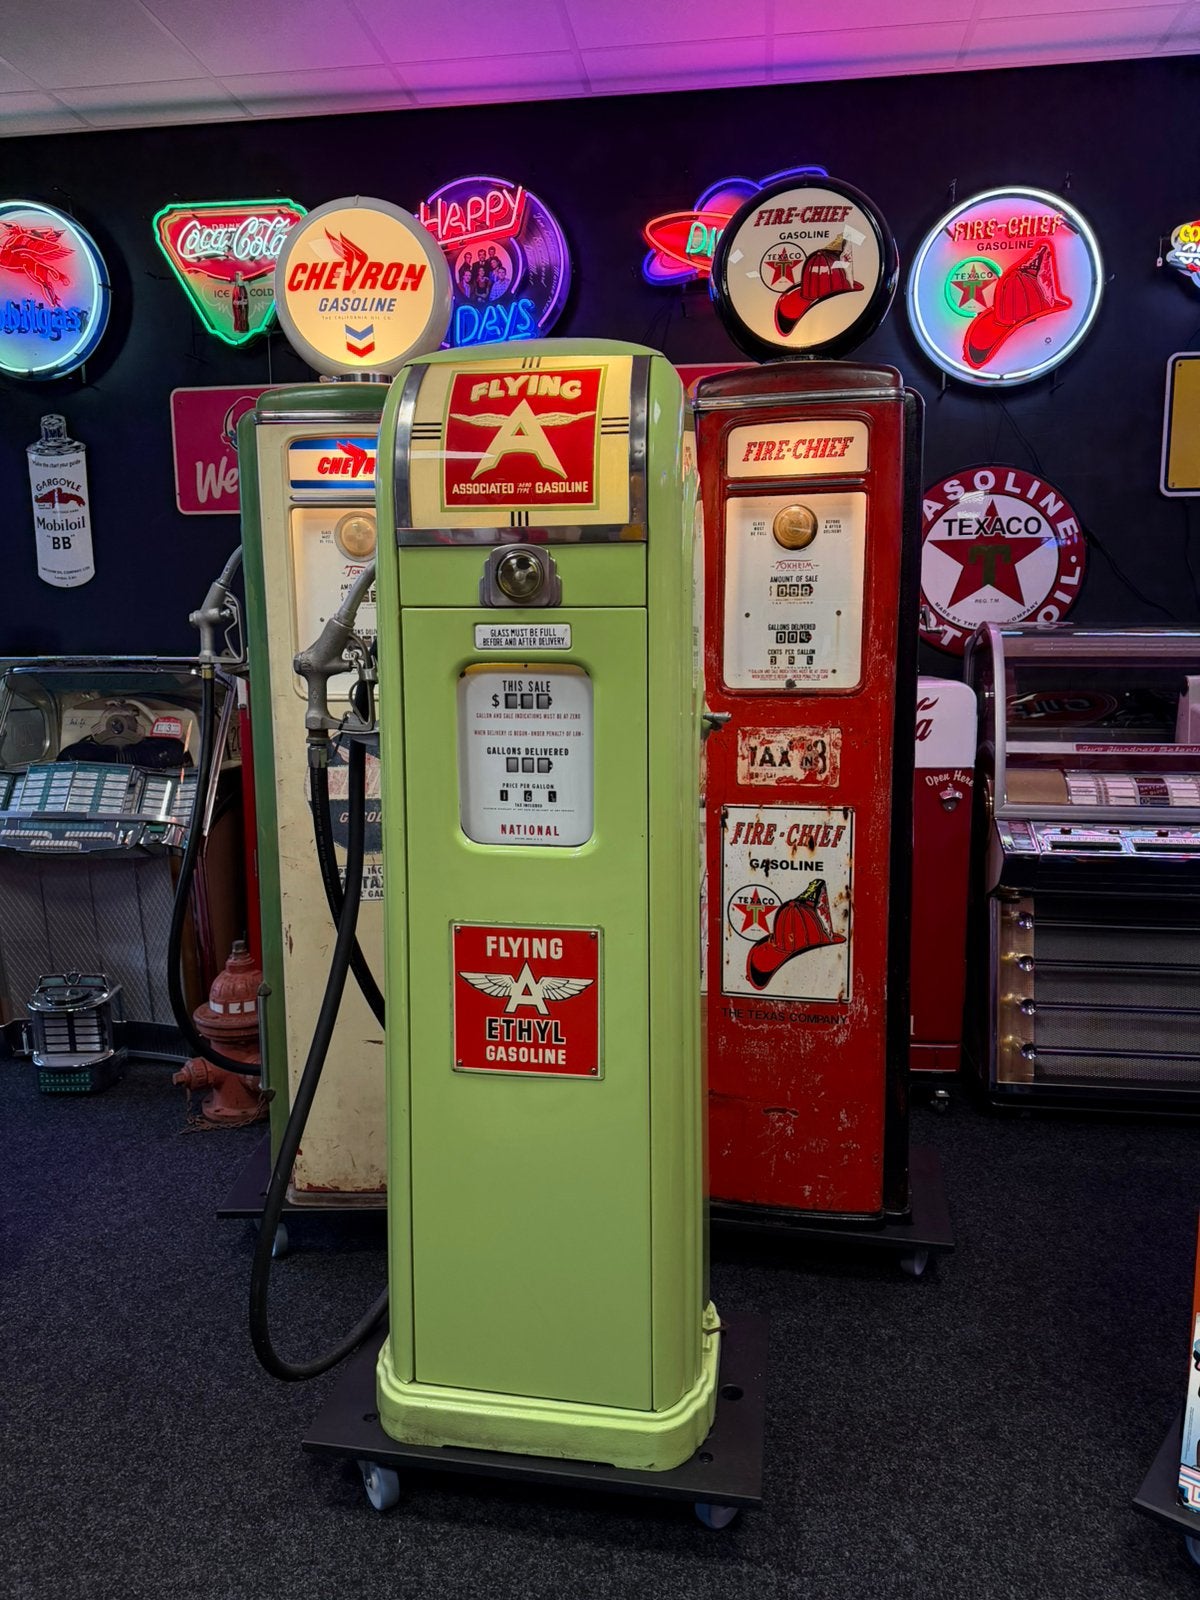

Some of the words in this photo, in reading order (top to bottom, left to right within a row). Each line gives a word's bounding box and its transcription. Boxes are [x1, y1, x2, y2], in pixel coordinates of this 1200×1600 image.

[420, 186, 523, 240] HAPPY
[754, 205, 853, 227] FIRE-CHIEF
[779, 230, 830, 240] GASOLINE
[954, 213, 1064, 242] FIRE-CHIEF
[177, 216, 290, 259] Coca-Cola
[976, 240, 1035, 251] GASOLINE
[767, 252, 801, 261] TEXACO
[287, 253, 428, 293] CHEVRON
[954, 271, 994, 280] TEXACO
[213, 290, 231, 298] ICE
[249, 288, 274, 297] COLD
[318, 297, 397, 312] GASOLINE
[456, 299, 534, 345] DAYS
[470, 374, 582, 402] FLYING
[742, 436, 854, 462] FIRE-CHIEF
[317, 451, 376, 478] CHEVR
[35, 477, 82, 492] GARGOYLE
[195, 455, 239, 504] We
[452, 482, 515, 494] ASSOCIATED
[535, 481, 589, 494] GASOLINE
[922, 470, 1080, 542] ASOLINE
[36, 515, 86, 531] Mobiloil
[943, 516, 1042, 536] TEXACO
[969, 545, 1011, 585] T
[795, 575, 803, 583] OF
[933, 601, 951, 617] MADE
[951, 615, 961, 623] BY
[490, 629, 509, 637] GLASS
[510, 628, 528, 637] MUST
[529, 628, 538, 637] BE
[540, 628, 556, 637] FULL
[791, 623, 816, 631] DELIVERED
[482, 638, 503, 646] BEFORE
[505, 638, 517, 646] AND
[518, 637, 537, 646] AFTER
[502, 680, 523, 692] THIS
[528, 681, 551, 692] SALE
[491, 693, 500, 708] $
[486, 747, 522, 755] GALLONS
[525, 747, 569, 756] DELIVERED
[925, 772, 951, 787] Open
[953, 770, 974, 787] Here
[500, 824, 560, 836] NATIONAL
[750, 858, 824, 873] GASOLINE
[737, 896, 775, 905] TEXACO
[486, 936, 563, 960] FLYING
[504, 960, 550, 1015] A
[721, 1007, 744, 1019] THE
[747, 1008, 785, 1022] TEXAS
[789, 1013, 848, 1025] COMPANY
[486, 1016, 566, 1045] ETHYL
[485, 1045, 566, 1065] GASOLINE
